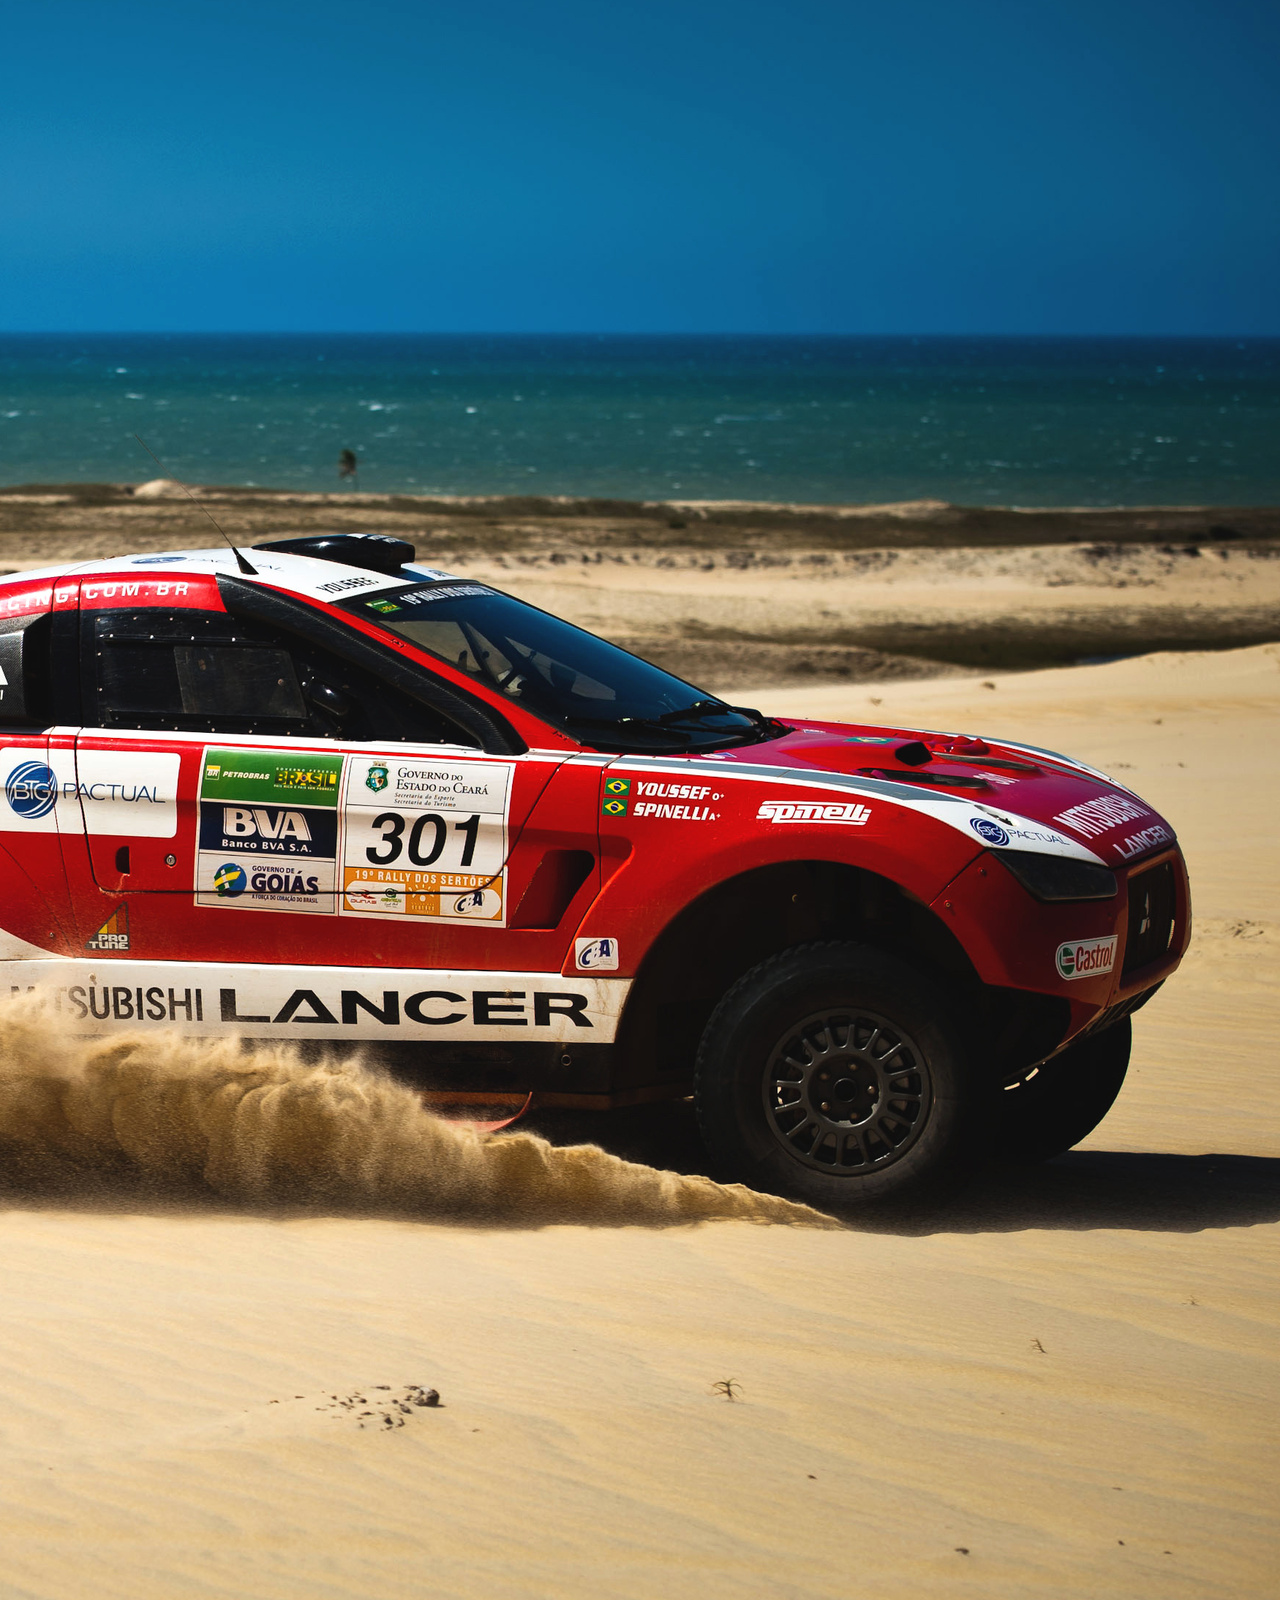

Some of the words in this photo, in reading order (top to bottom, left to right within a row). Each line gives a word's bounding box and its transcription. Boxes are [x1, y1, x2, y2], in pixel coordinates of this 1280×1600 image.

[223, 770, 270, 780] PETROBRAS
[275, 771, 337, 787] BRASIL
[397, 767, 449, 781] GOVERNO
[13, 783, 52, 800] BTG
[63, 783, 166, 803] PACTUAL
[396, 779, 437, 793] ESTADO
[453, 782, 489, 795] CEARÁ
[637, 781, 712, 800] YOUSSEF
[633, 802, 710, 821] SPINELLI
[1052, 794, 1151, 840] MITSUBISHI
[223, 807, 312, 841] BVA
[222, 839, 257, 849] Banco
[262, 842, 285, 851] BVA
[290, 844, 312, 852] S.A.
[365, 812, 481, 867] 301
[1007, 829, 1070, 846] PACTUAL
[1113, 825, 1170, 859] LANCER
[252, 865, 285, 874] GOVERNO
[251, 870, 319, 895] GOIÁS
[355, 870, 374, 880] 19º
[378, 871, 411, 883] RALLY
[415, 873, 437, 884] DOS
[440, 874, 491, 888] SERTÕES
[89, 941, 129, 950] TUNE
[98, 934, 128, 942] PRO
[1074, 942, 1114, 972] Castrol
[220, 989, 594, 1027] LANCER
